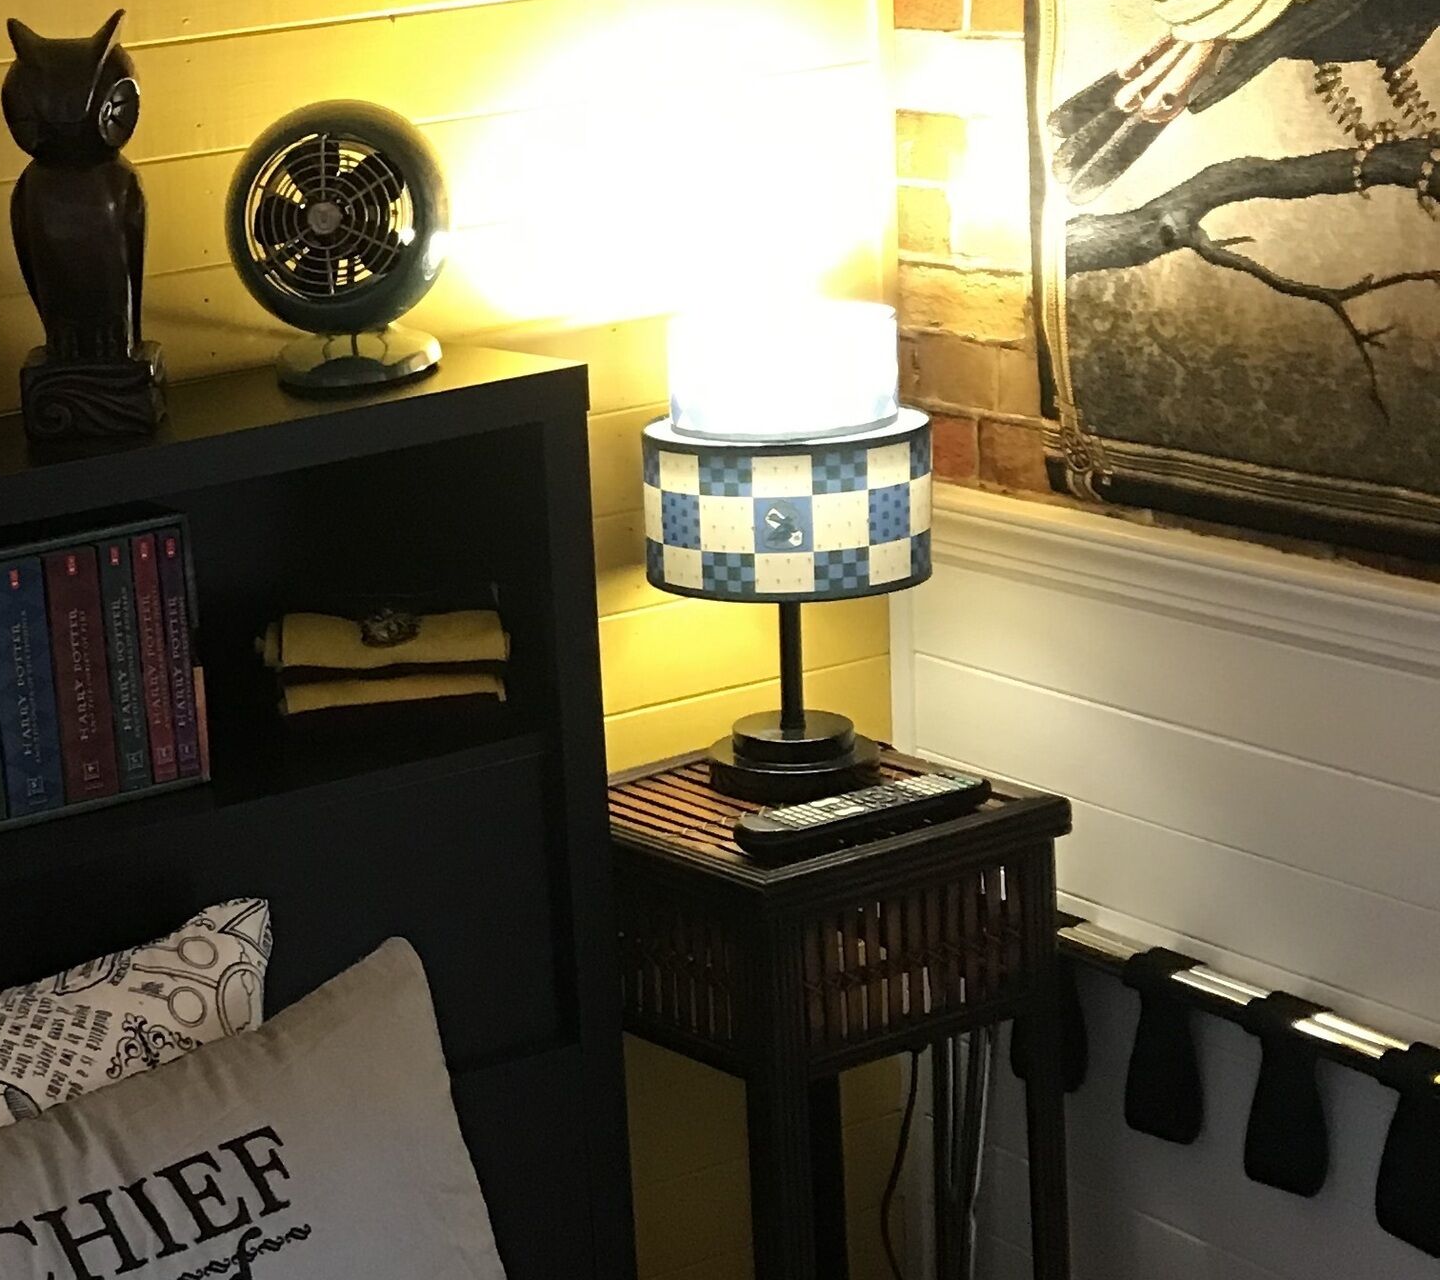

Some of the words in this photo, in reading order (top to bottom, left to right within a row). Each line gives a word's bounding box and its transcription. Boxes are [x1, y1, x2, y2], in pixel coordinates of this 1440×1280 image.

[12, 623, 26, 686] POTTER
[68, 609, 83, 671] POTTER
[112, 599, 125, 663] POTTER
[169, 596, 181, 658] POTTER
[18, 695, 34, 756] HARRY
[75, 680, 90, 740] HARRY
[119, 671, 133, 731] HARRY
[173, 667, 186, 726] HARRY
